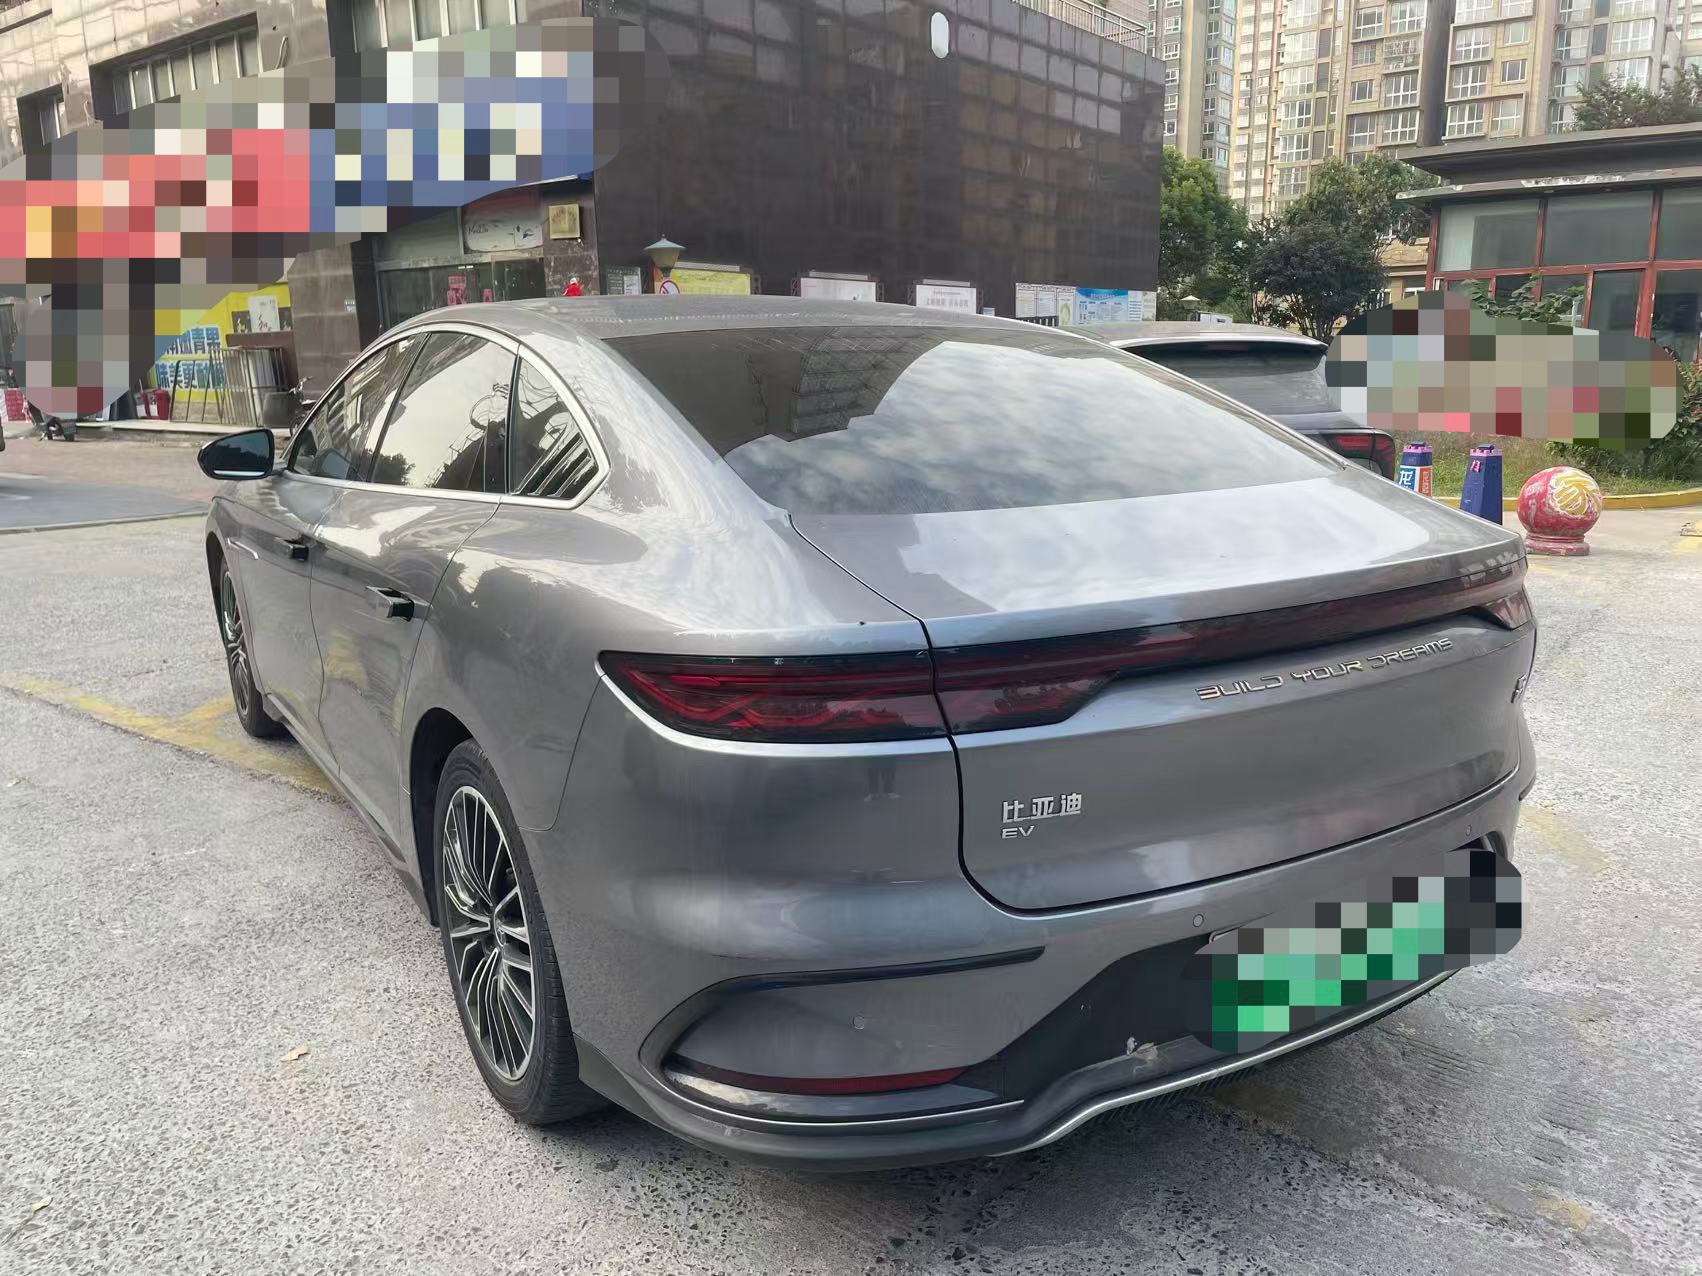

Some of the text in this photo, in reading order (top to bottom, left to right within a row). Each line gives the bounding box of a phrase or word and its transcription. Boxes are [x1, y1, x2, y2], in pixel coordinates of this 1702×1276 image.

[1195, 637, 1454, 701] BUILD YOUR DREAMS
[1002, 792, 1083, 823] 比亚迪
[1001, 825, 1035, 839] EV
